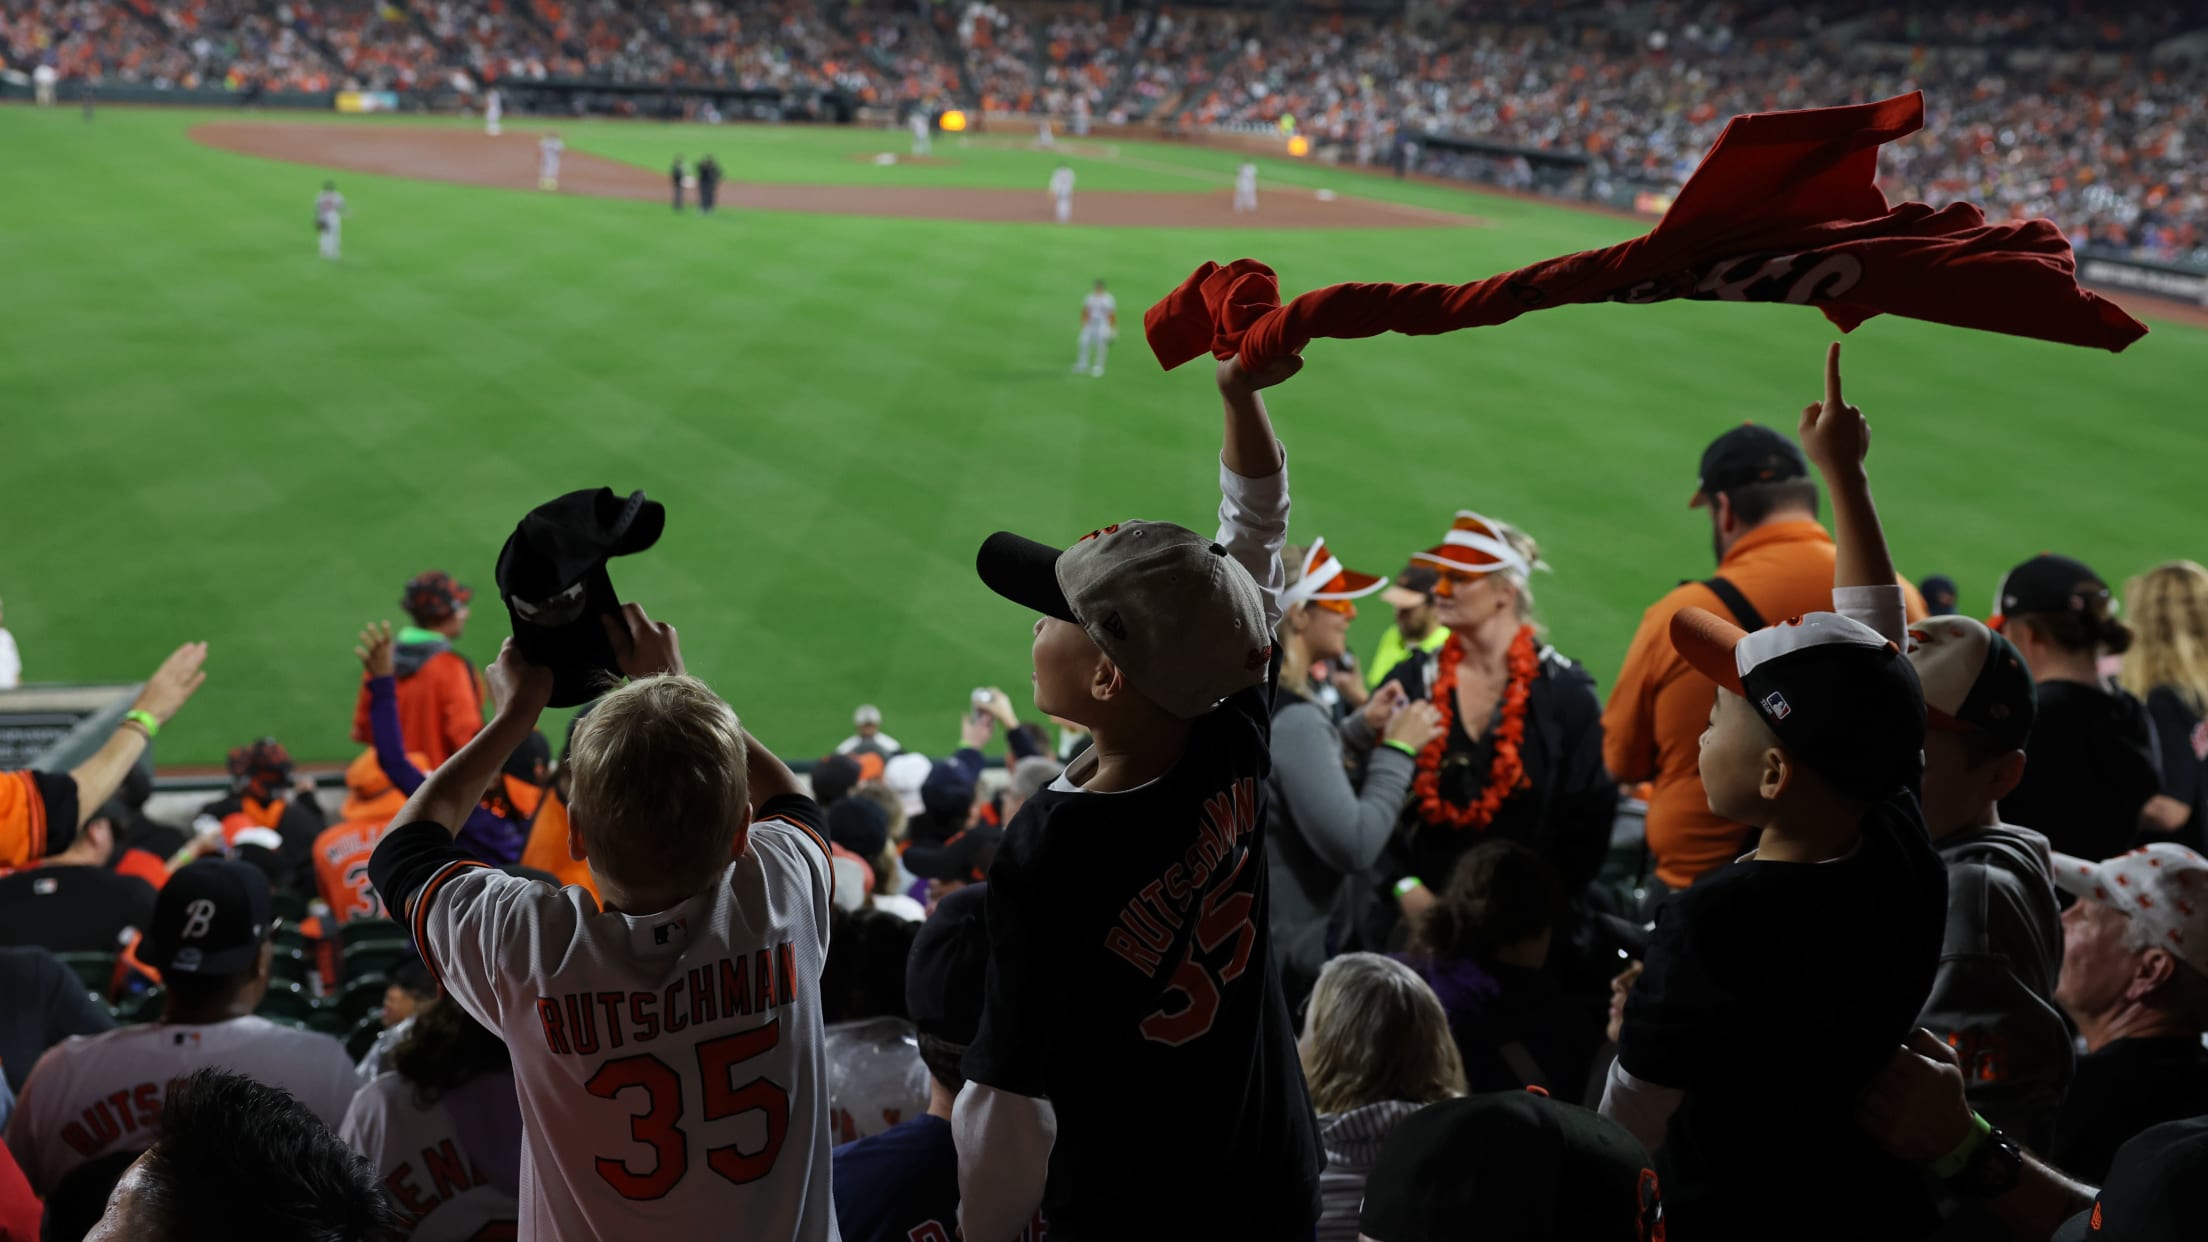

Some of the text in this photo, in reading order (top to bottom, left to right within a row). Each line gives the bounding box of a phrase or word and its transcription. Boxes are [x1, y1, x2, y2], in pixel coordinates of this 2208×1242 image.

[180, 898, 216, 940] B
[1104, 776, 1255, 979] RUTSCHMN
[536, 941, 796, 1055] RUTSCHMAN
[61, 1079, 188, 1157] RUTS
[584, 1017, 790, 1201] 35
